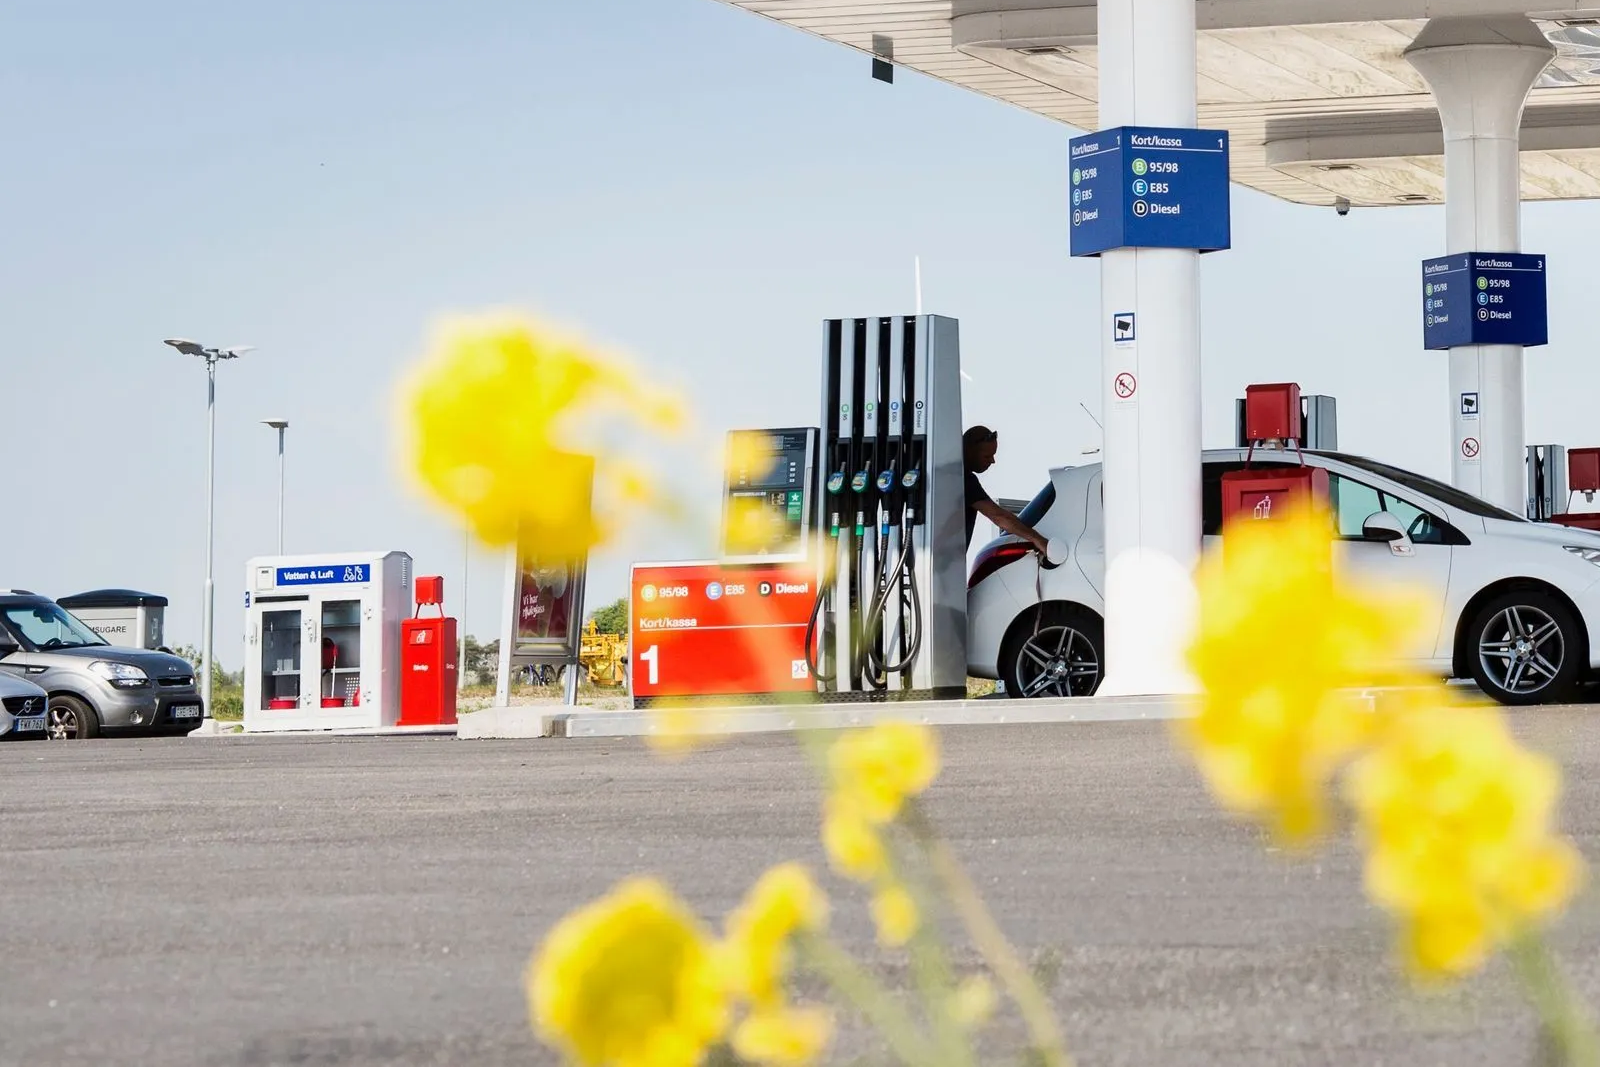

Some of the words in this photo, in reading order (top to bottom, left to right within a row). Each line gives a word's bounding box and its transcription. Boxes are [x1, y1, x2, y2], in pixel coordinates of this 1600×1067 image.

[1072, 143, 1099, 156] Kort/kassa
[1116, 136, 1121, 145] 1
[1131, 135, 1182, 147] Kort/kassa
[1217, 138, 1223, 148] 1
[1136, 162, 1143, 171] B
[1149, 162, 1178, 173] 95/98
[1081, 167, 1097, 180] 95/98
[1137, 183, 1143, 192] E
[1150, 183, 1169, 193] E85
[1082, 189, 1092, 200] E85
[1137, 204, 1145, 213] D
[1150, 204, 1180, 214] Diesel
[1082, 209, 1098, 221] Diesel
[1425, 264, 1449, 274] Kort/kassa
[1464, 259, 1468, 267] 3
[1476, 259, 1513, 268] Kort/kassa
[1537, 260, 1542, 268] 3
[1433, 283, 1447, 292] 95/98
[1489, 279, 1510, 288] 95/98
[1434, 299, 1443, 308] E85
[1489, 295, 1503, 303] E85
[1434, 314, 1448, 324] Diesel
[1490, 311, 1512, 319] Diesel
[283, 572, 309, 581] Vatten
[310, 571, 316, 579] &
[318, 570, 334, 579] Luft
[659, 586, 688, 598] 95/98
[725, 584, 745, 595] E85
[760, 584, 770, 594] D
[775, 583, 808, 594] Diesel
[522, 594, 529, 605] Vi
[639, 617, 697, 629] Kort/kassa
[640, 644, 659, 685] 1
